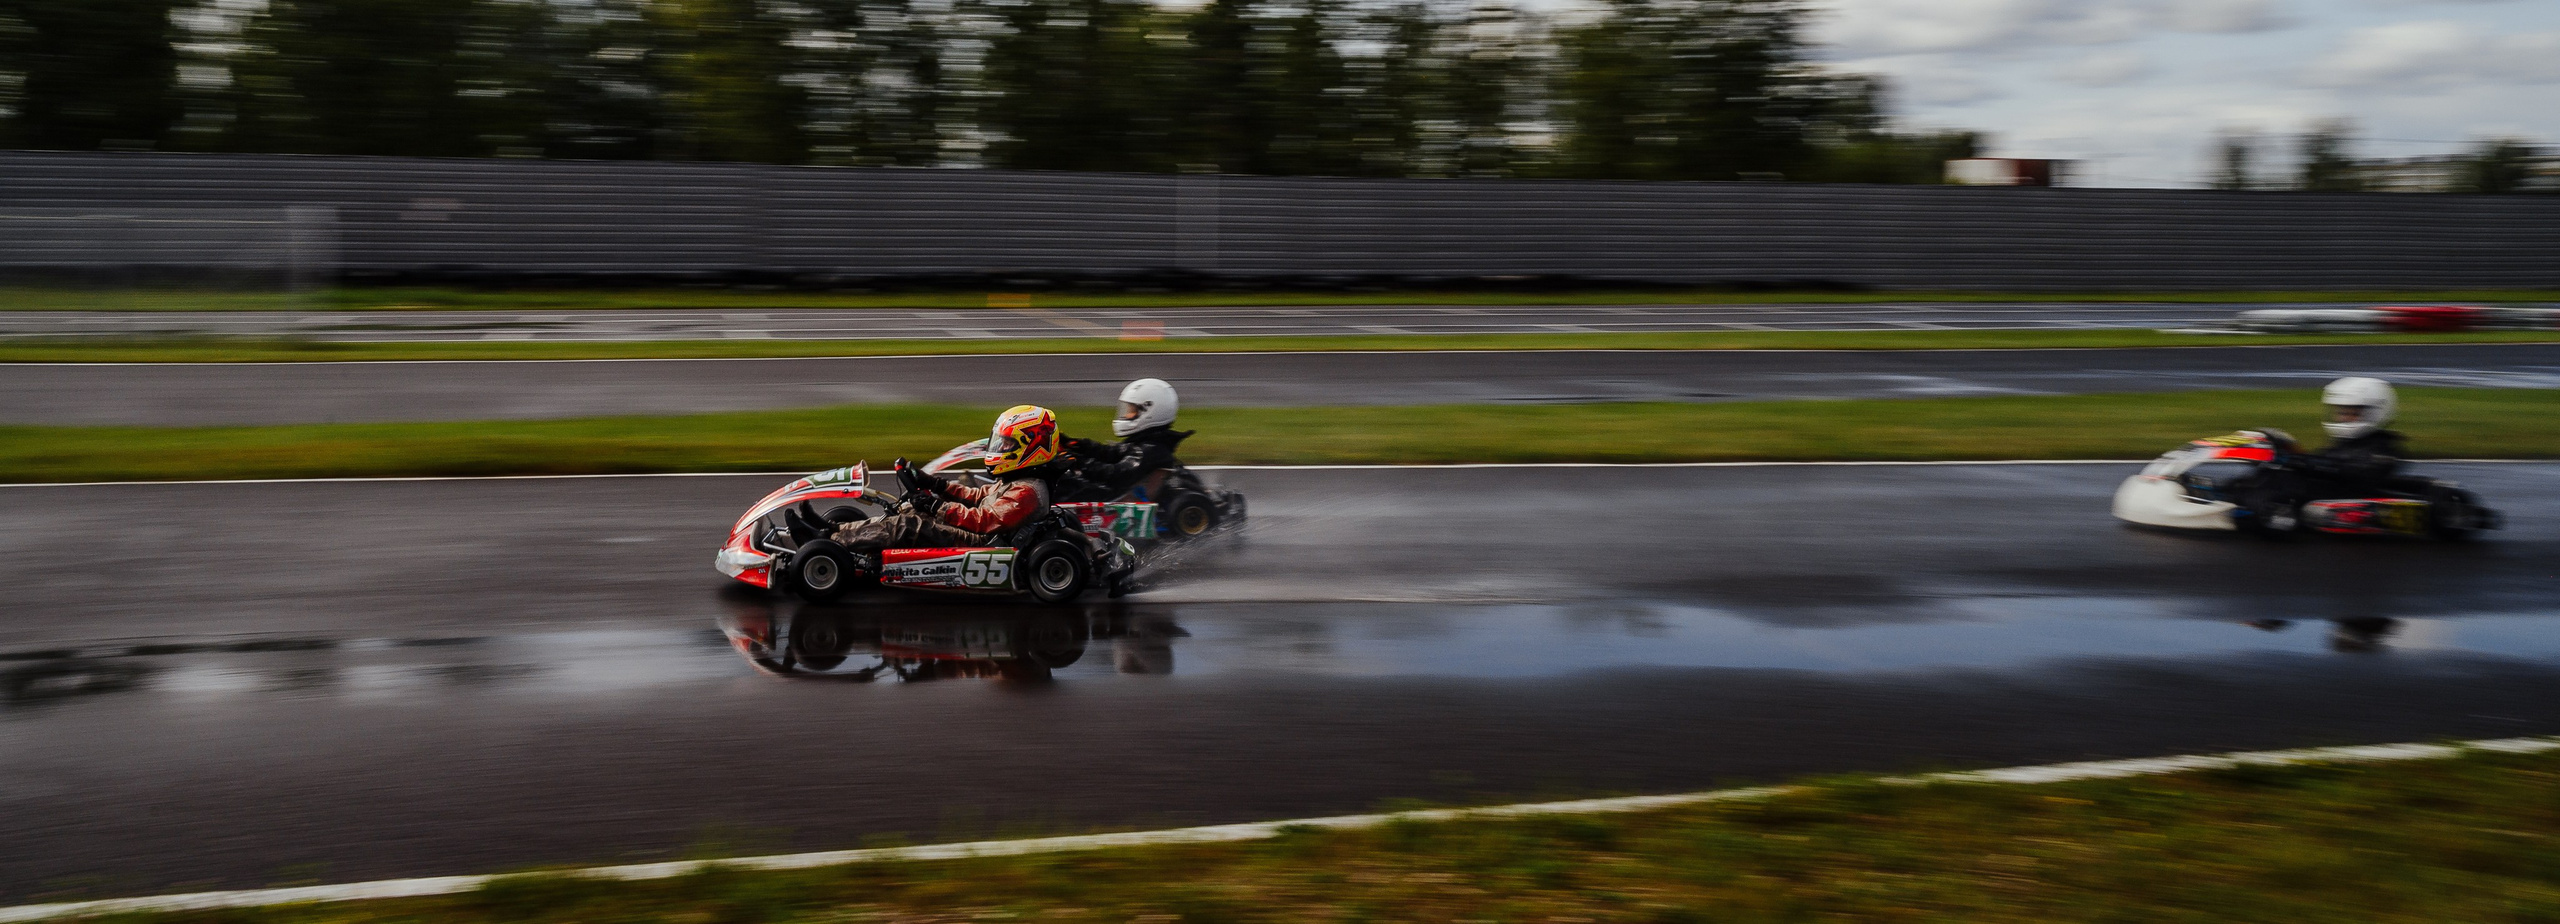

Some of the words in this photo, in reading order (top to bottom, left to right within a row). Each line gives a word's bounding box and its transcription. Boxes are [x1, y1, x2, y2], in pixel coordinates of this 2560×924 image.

[886, 567, 920, 577] Nikita
[921, 565, 957, 576] Galkin
[964, 554, 1013, 585] 55
